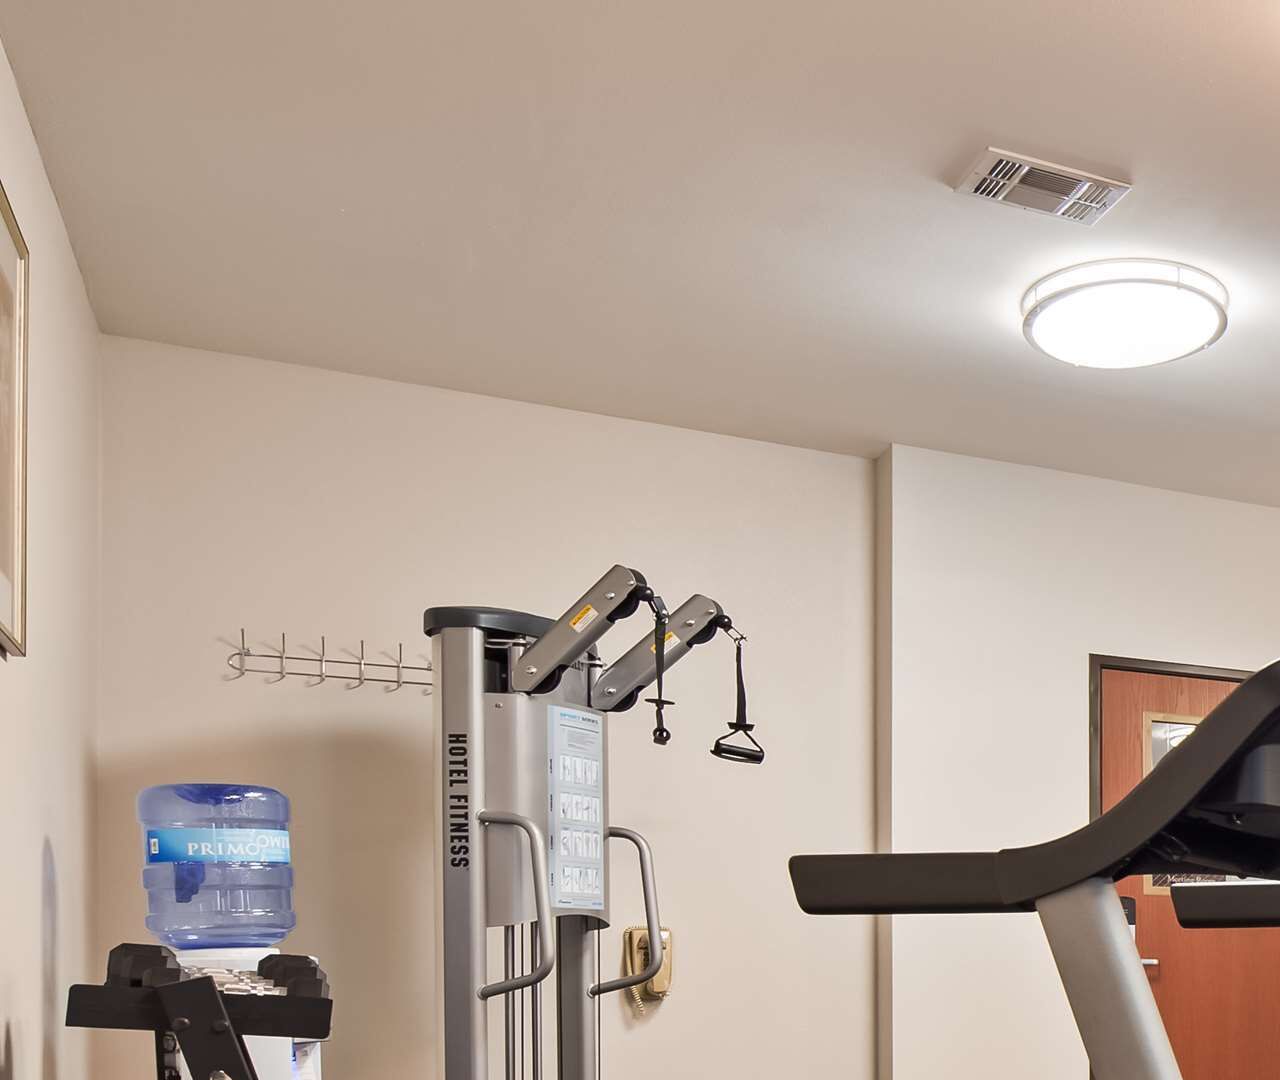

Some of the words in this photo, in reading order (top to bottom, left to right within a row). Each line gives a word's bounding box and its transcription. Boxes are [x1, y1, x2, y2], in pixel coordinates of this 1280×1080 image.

[448, 733, 468, 787] HOTEL
[187, 841, 259, 856] PRIMO
[449, 794, 469, 868] FITNESS
